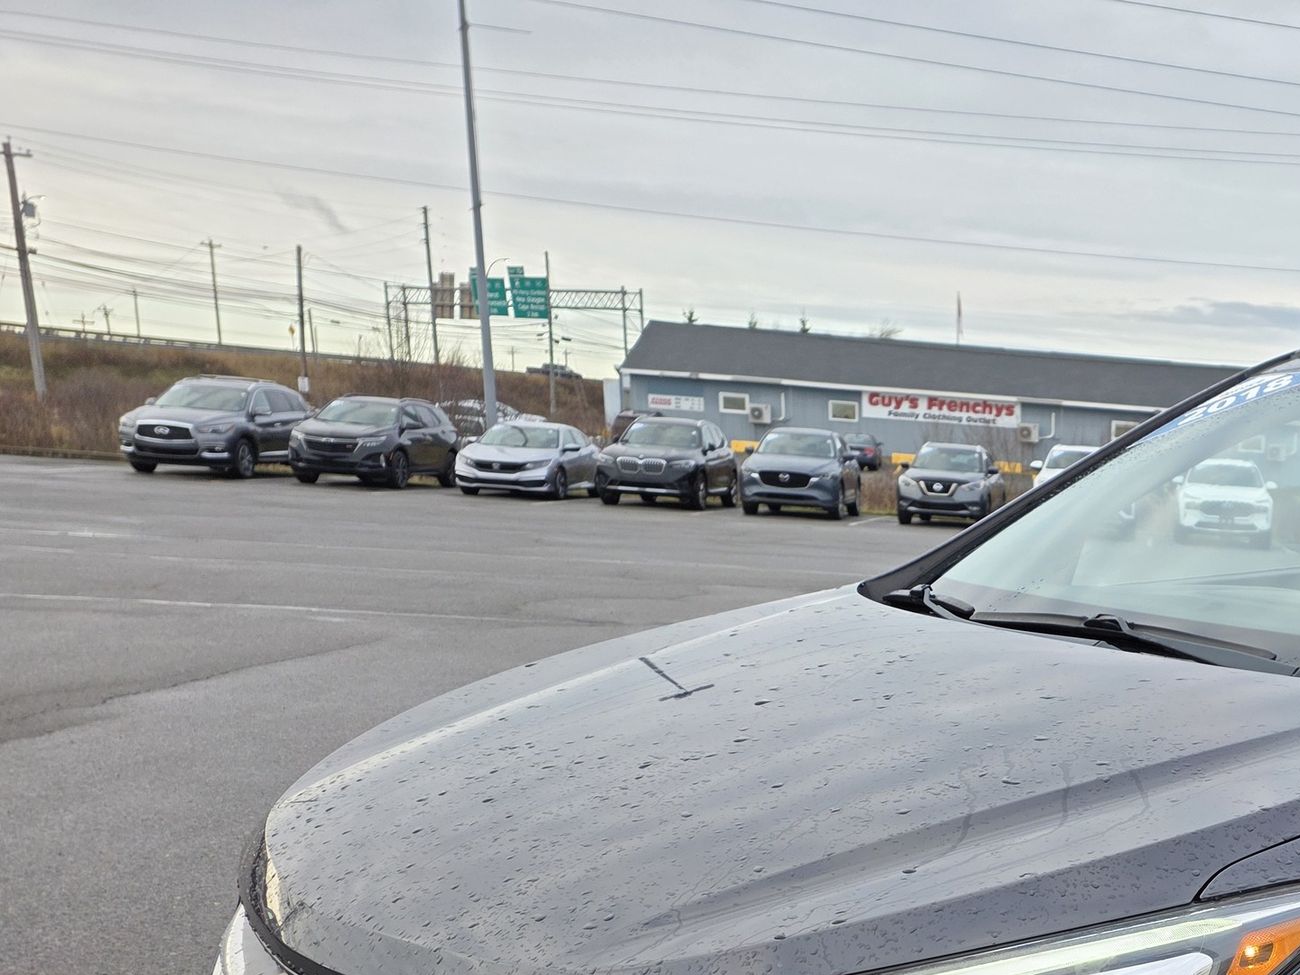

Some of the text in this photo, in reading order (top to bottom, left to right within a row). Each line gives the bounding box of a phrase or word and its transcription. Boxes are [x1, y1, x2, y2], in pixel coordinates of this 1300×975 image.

[868, 392, 1015, 417] Guy's Frenchys
[1177, 374, 1293, 426] 2018
[888, 410, 997, 425] Family Clothing Outlet
